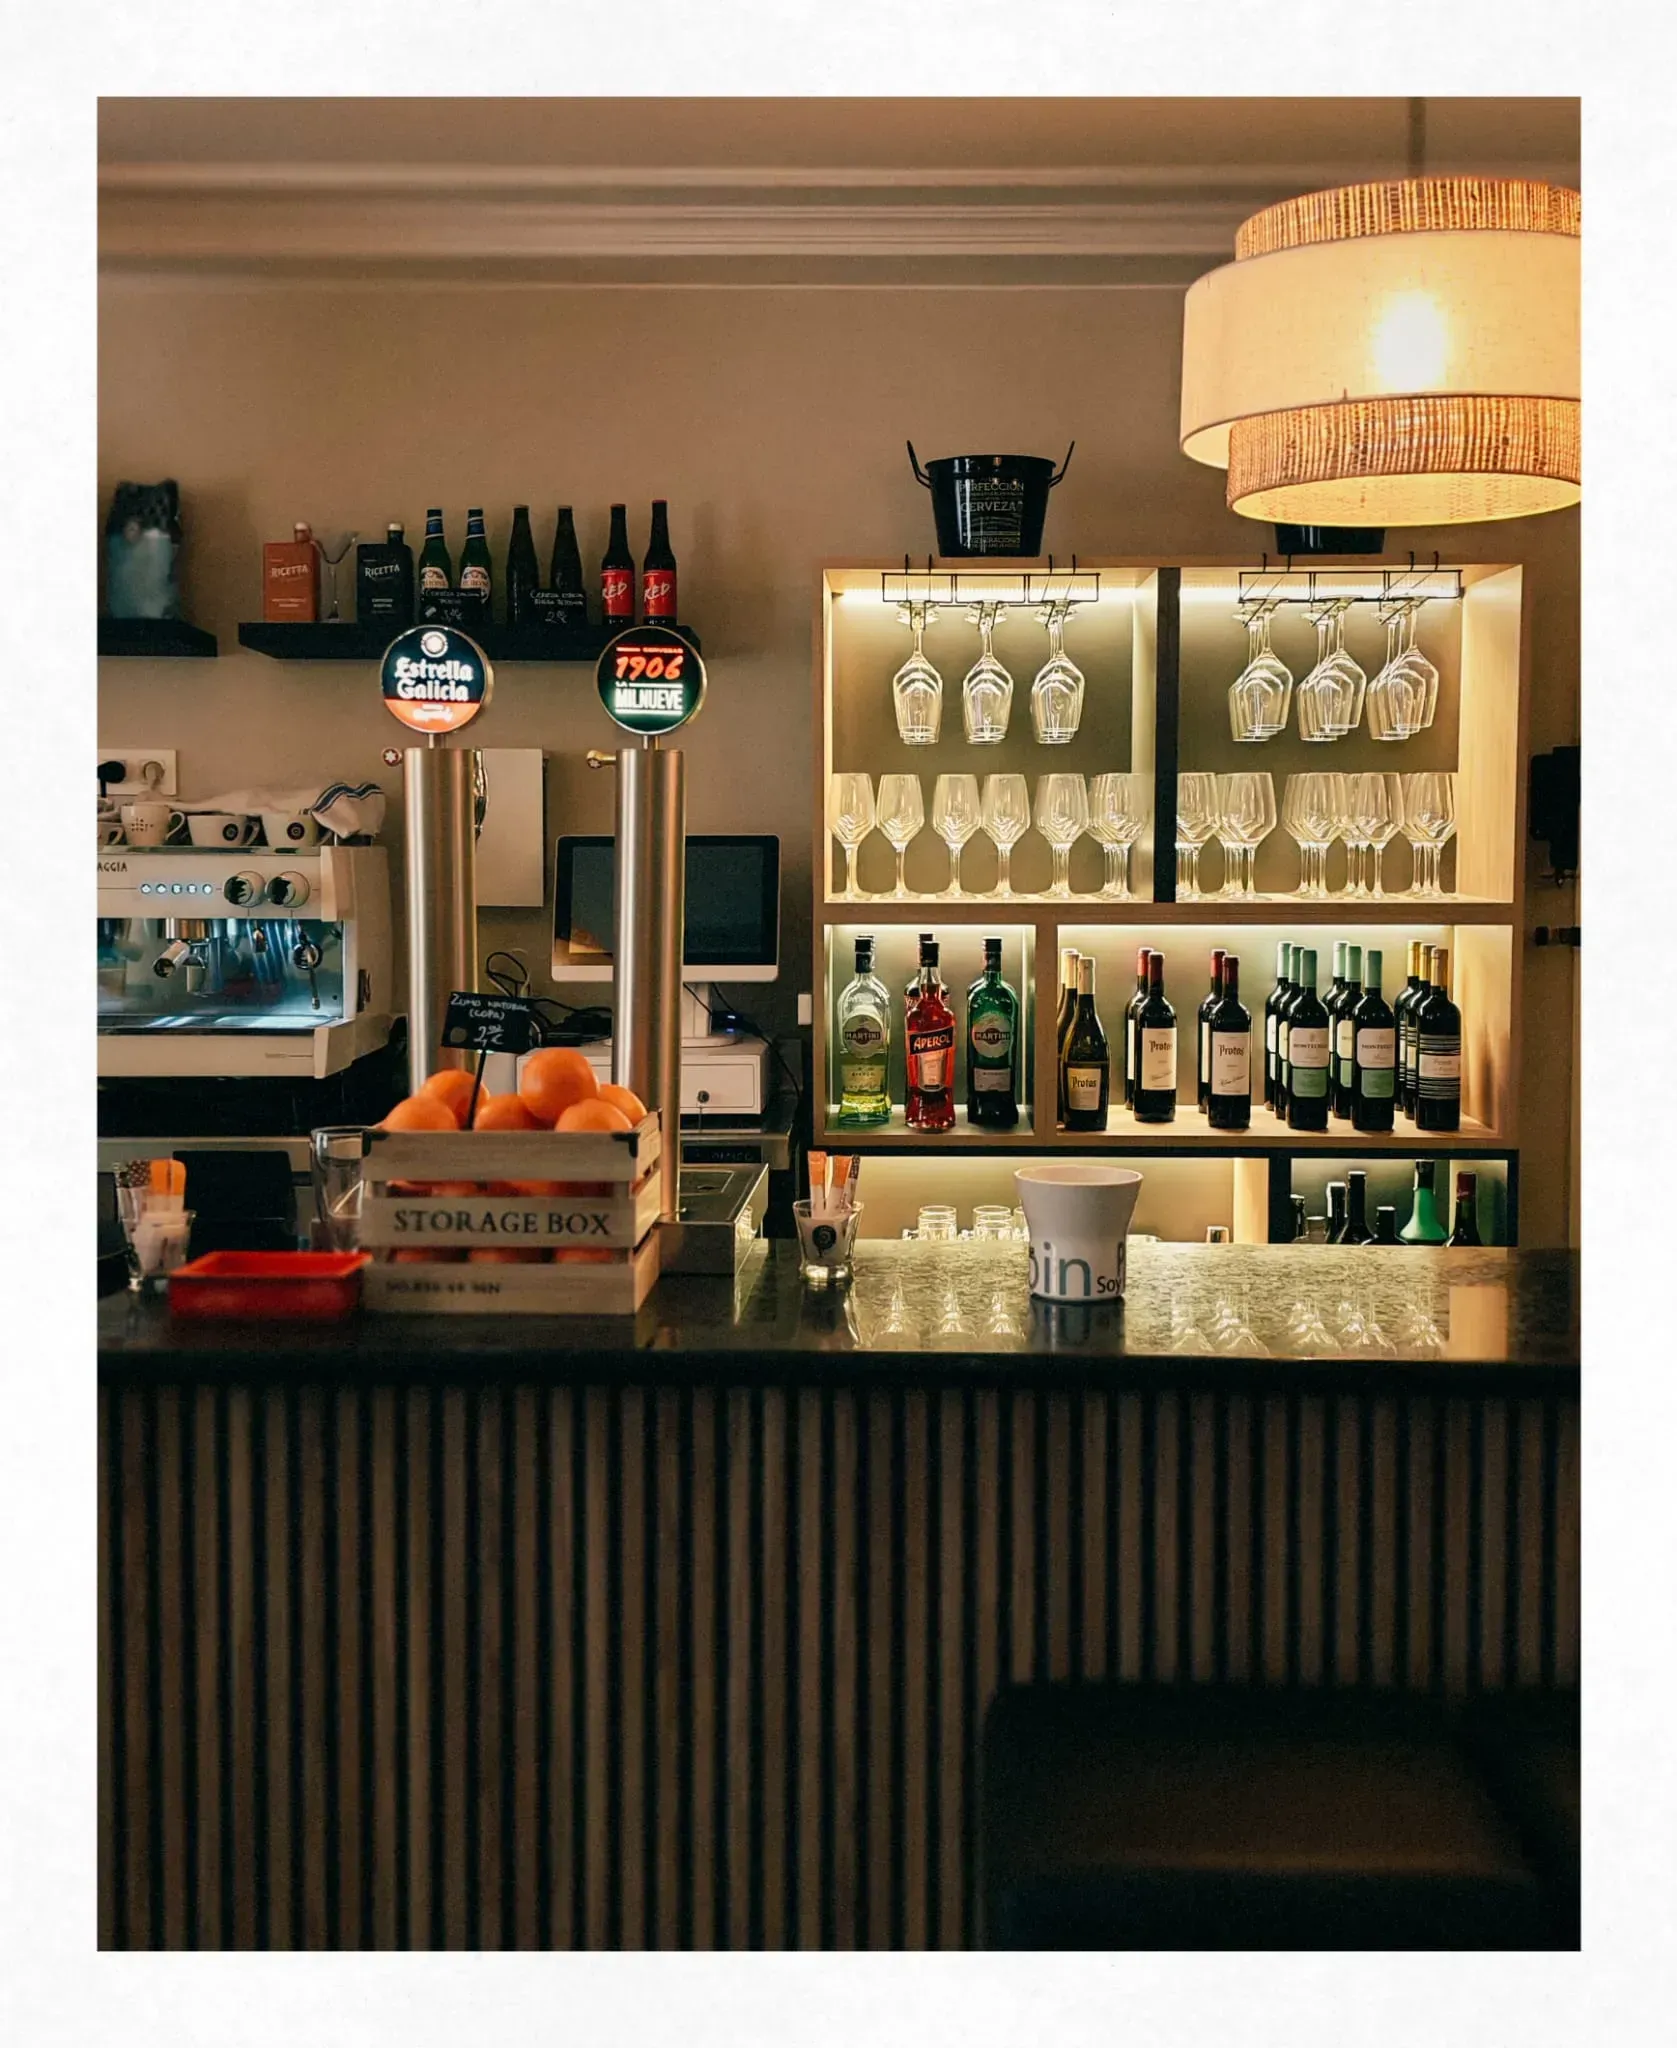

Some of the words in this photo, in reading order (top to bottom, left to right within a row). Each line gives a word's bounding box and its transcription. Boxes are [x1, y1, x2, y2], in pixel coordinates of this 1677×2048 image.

[271, 564, 309, 578] RICETTA
[364, 564, 400, 577] RICETTA
[601, 581, 627, 600] RED
[643, 581, 670, 601] RED
[394, 656, 474, 682] Estrella
[615, 655, 684, 681] 1906
[396, 678, 469, 702] Galicia
[614, 687, 684, 710] MILNUEVE
[845, 1031, 880, 1041] MARTINI
[913, 1033, 951, 1052] APEROL
[976, 1032, 1011, 1041] MARTINI
[1217, 1044, 1245, 1057] Protos
[1070, 1075, 1097, 1089] Protos
[393, 1209, 538, 1234] STORAGE
[547, 1212, 612, 1236] BOX
[1097, 1275, 1121, 1296] Soy
